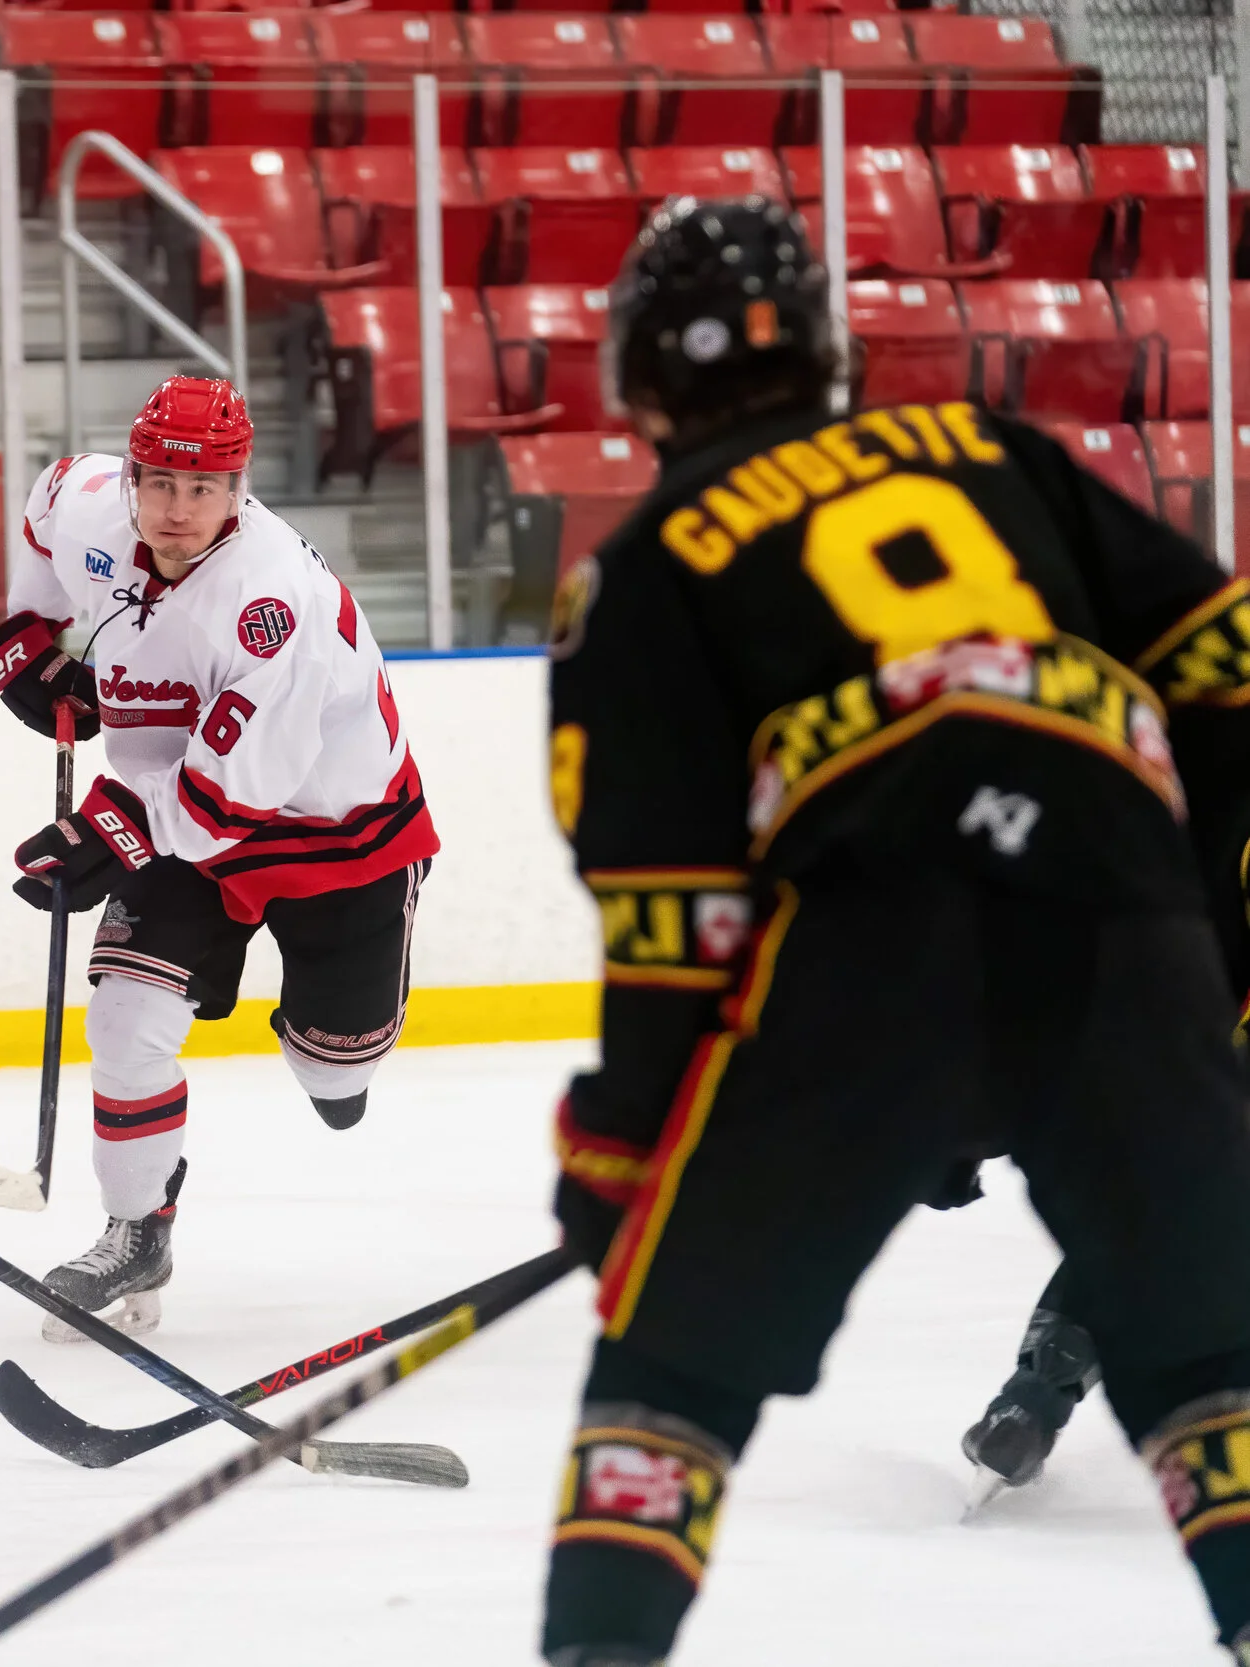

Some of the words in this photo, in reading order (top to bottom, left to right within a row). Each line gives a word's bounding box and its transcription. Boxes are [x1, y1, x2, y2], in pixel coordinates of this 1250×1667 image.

[162, 438, 203, 453] TITANS
[658, 400, 1006, 577] GAUDETTE
[189, 689, 258, 757] 6
